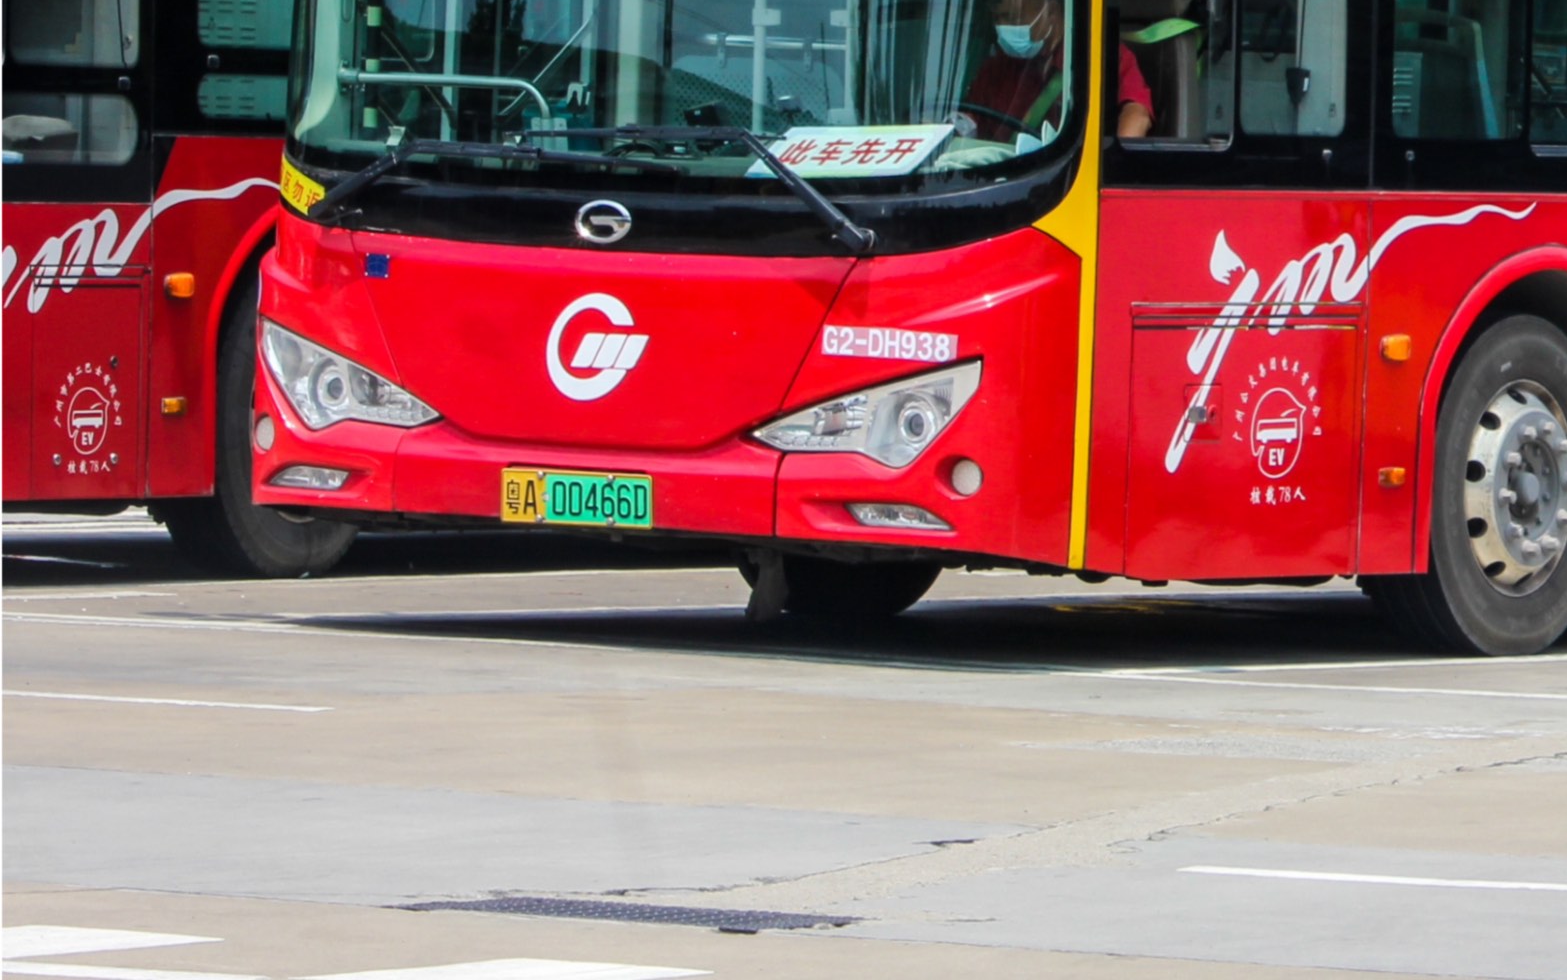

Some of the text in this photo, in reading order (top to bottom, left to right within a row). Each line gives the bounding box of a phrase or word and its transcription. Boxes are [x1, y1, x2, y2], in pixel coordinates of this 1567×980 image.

[778, 138, 924, 166] 此车先开
[822, 326, 950, 362] G2-DH938
[81, 431, 94, 446] EV
[1268, 447, 1285, 466] EV
